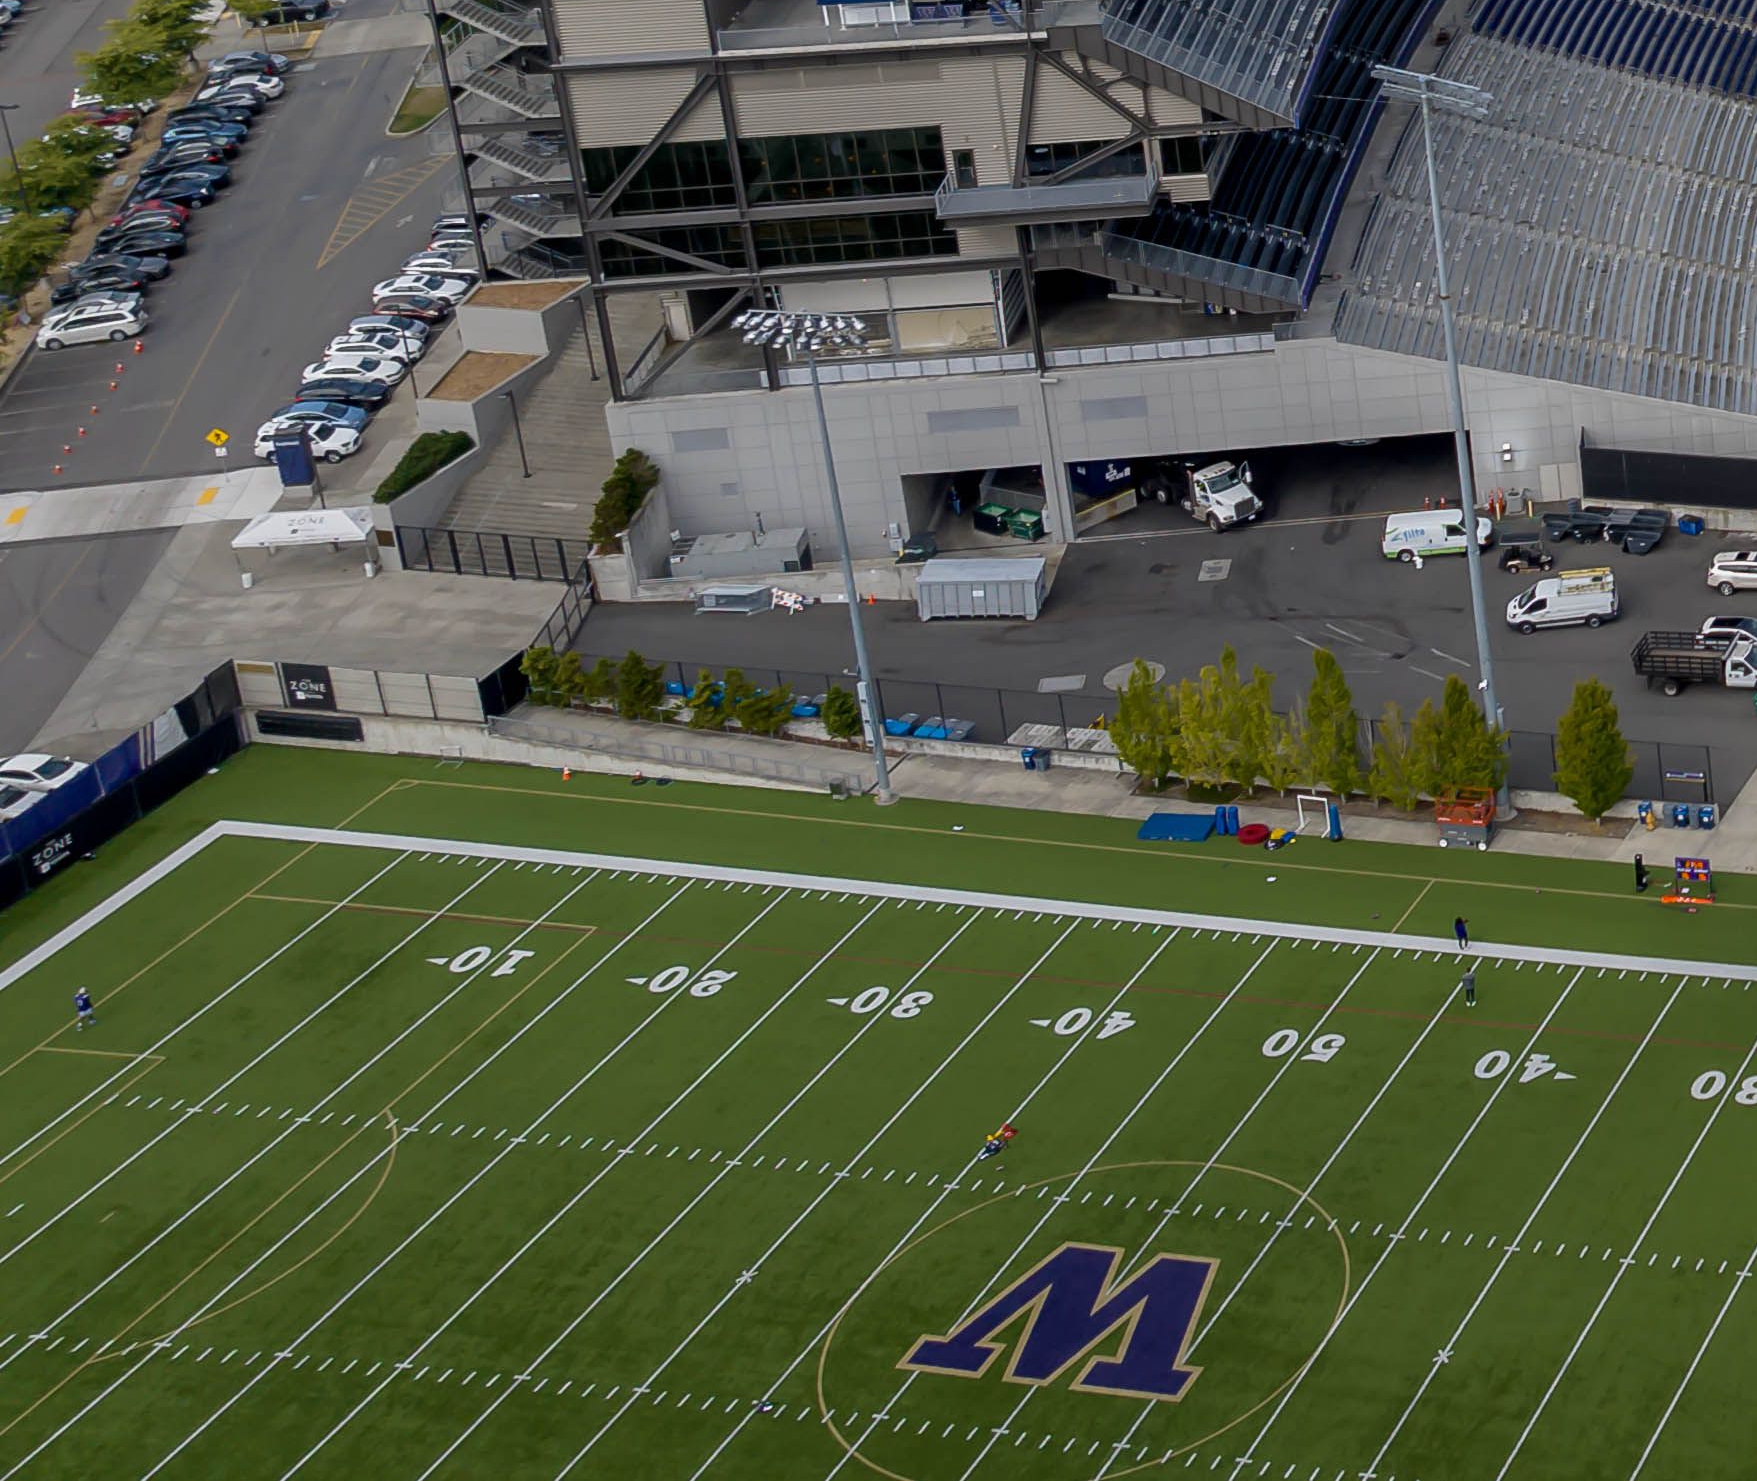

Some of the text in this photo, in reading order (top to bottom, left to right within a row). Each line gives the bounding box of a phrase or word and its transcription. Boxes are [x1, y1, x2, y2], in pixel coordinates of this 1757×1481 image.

[290, 680, 327, 693] ZONE
[32, 832, 73, 867] ZONE
[447, 945, 535, 977] 10
[647, 964, 738, 998] 20
[849, 985, 935, 1019] 30
[1052, 1006, 1137, 1041] 40
[1261, 1028, 1346, 1064] 50
[1473, 1049, 1557, 1085] 40
[895, 1241, 1221, 1403] W
